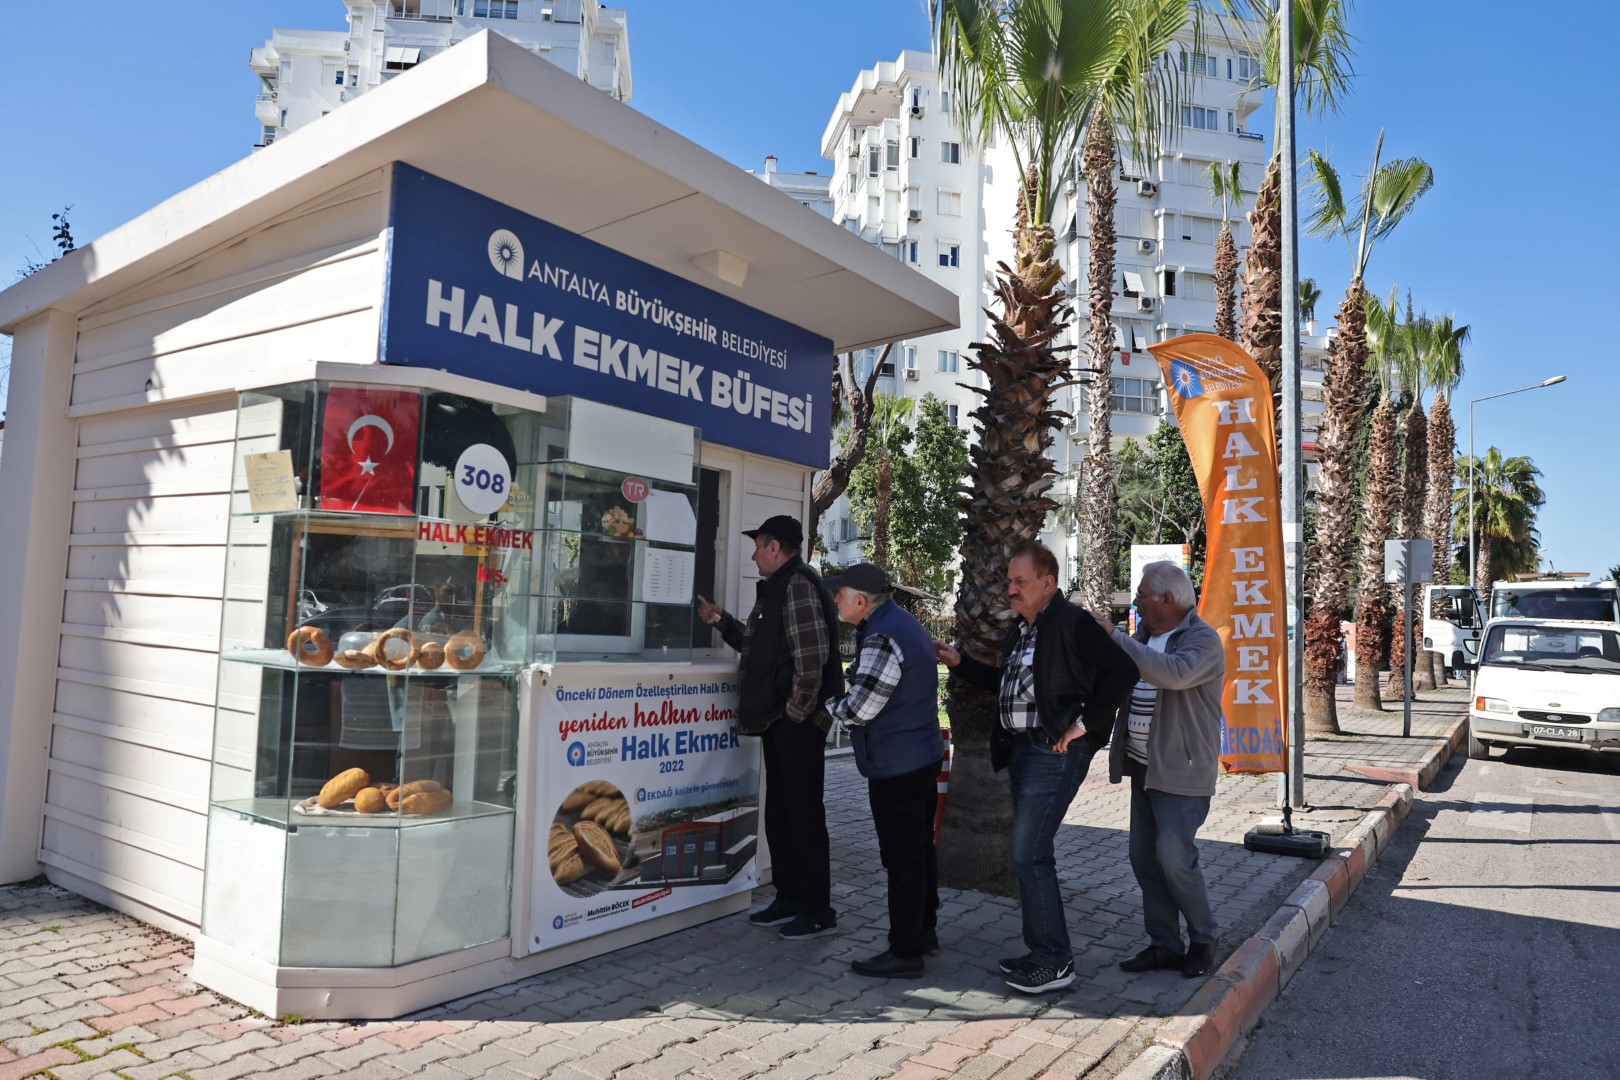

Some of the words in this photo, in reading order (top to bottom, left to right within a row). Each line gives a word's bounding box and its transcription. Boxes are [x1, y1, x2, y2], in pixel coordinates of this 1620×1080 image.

[528, 259, 610, 306] ANTALYA
[615, 289, 717, 345] BÜYÜKŞEHİR
[721, 330, 787, 370] BELEDİYESİ
[425, 279, 564, 361] HALK
[573, 325, 703, 402] EKMEK
[710, 369, 812, 433] BÜFESİ
[1212, 397, 1267, 525] HALK
[461, 464, 505, 494] 308
[626, 482, 645, 497] TR
[418, 521, 468, 544] HALK
[474, 525, 533, 550] EKMEK
[477, 563, 508, 588] krş.
[1231, 546, 1276, 705] EKMEK
[556, 685, 595, 701] Önceki
[599, 686, 634, 699] Dönem
[636, 683, 698, 699] Özelleştirilen
[700, 683, 720, 694] Halk
[559, 711, 630, 741] yeniden
[633, 700, 702, 728] halkın
[587, 740, 609, 749] ANTALYA
[621, 733, 670, 761] Halk
[675, 725, 740, 755] Ekmek
[1228, 718, 1284, 755] EKDAĞ
[659, 759, 684, 774] 2022
[647, 787, 673, 800] EKDAĞ
